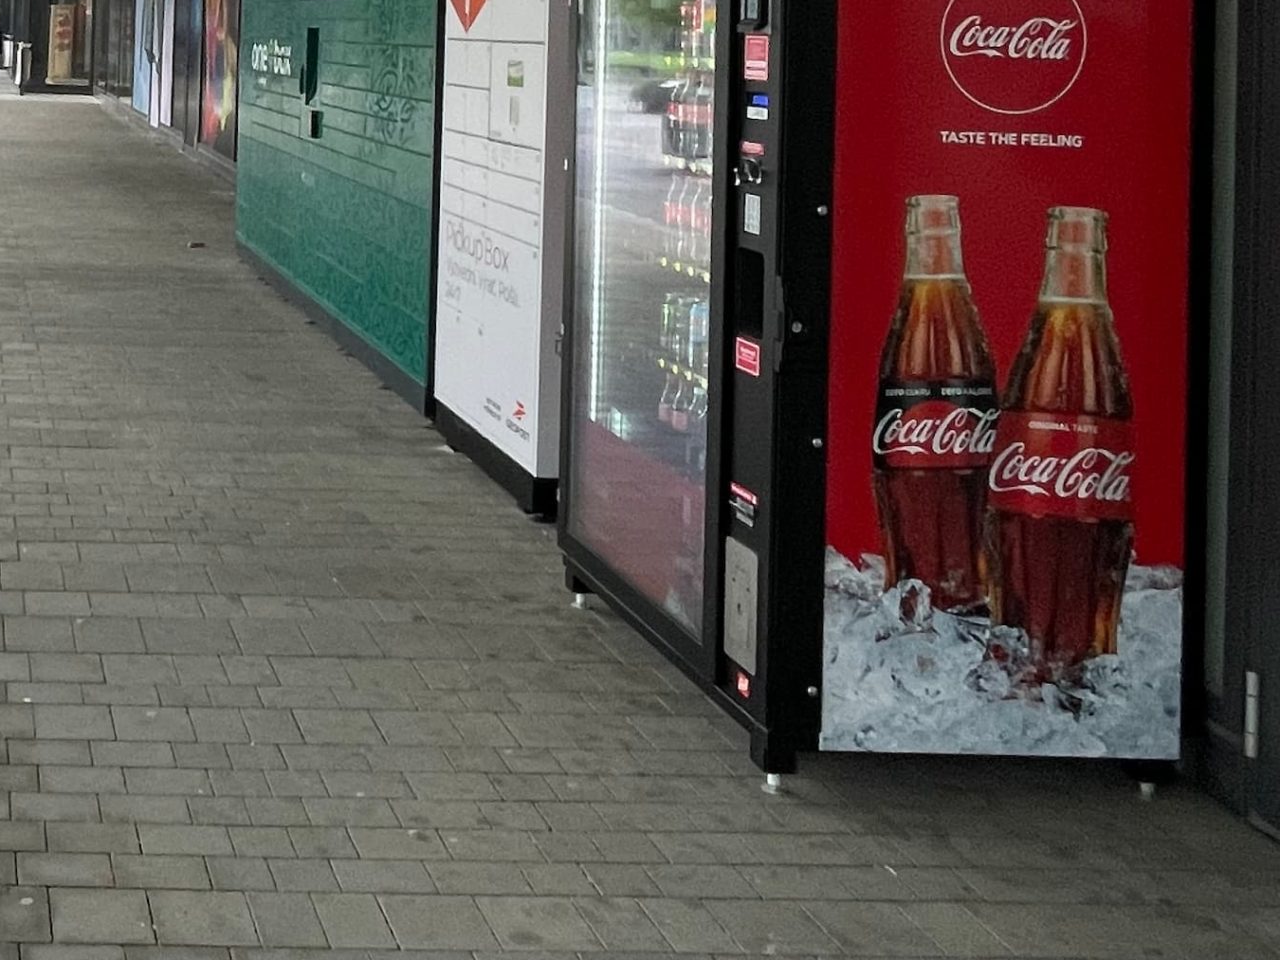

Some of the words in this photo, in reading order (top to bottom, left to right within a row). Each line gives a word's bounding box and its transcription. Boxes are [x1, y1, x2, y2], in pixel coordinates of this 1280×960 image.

[949, 15, 1079, 61] Coca-Cola
[940, 131, 986, 144] TASTE
[988, 132, 1018, 146] THE
[1021, 133, 1083, 148] FEELING
[873, 407, 1001, 455] Coca-Cola
[1028, 421, 1070, 432] ORIGINAL
[1073, 423, 1099, 434] TASTE
[989, 442, 1136, 501] Coca-Cola
